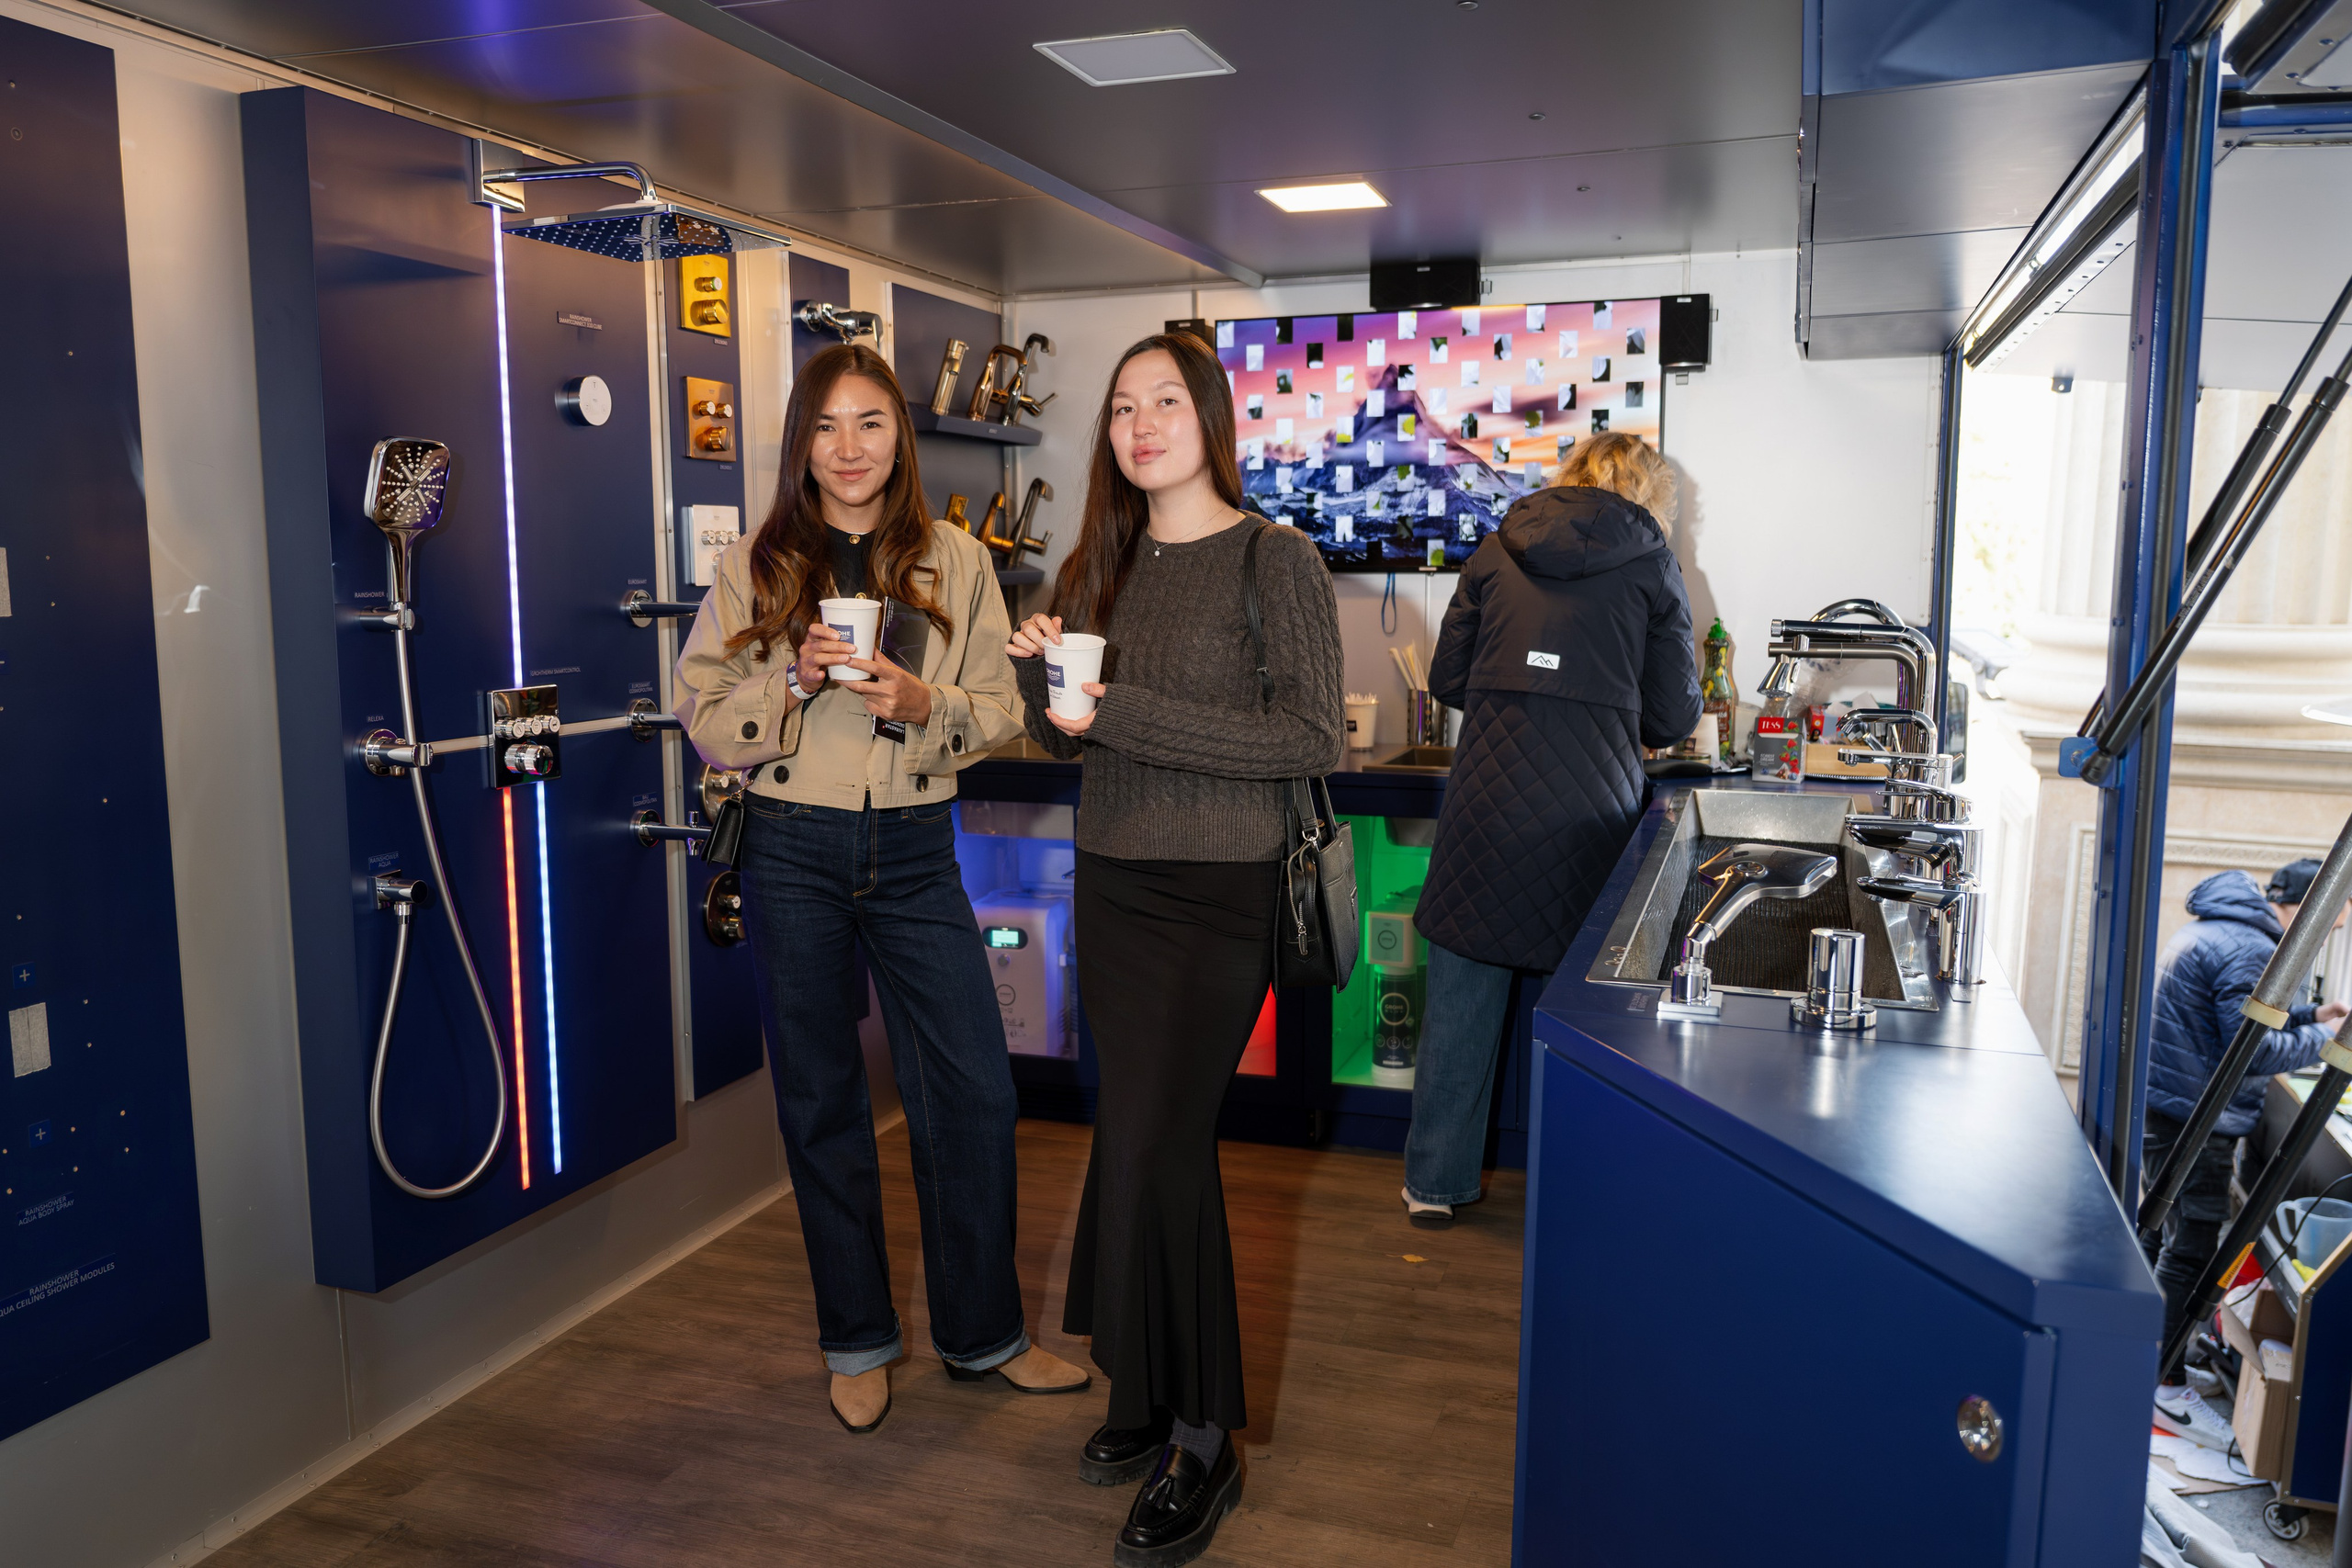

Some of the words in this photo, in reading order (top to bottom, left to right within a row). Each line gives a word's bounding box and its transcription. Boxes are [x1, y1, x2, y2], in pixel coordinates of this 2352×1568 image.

[1762, 720, 1781, 729] TESS
[369, 853, 399, 863] RAINSHOWER
[18, 1214, 37, 1226] AQUA
[38, 1208, 54, 1219] BODY
[56, 1200, 74, 1213] SPRAY
[25, 1195, 67, 1216] RAINSHOWER
[0, 1305, 15, 1317] QUA
[16, 1292, 45, 1309] CEILING
[47, 1278, 79, 1297] SHOWER
[80, 1262, 115, 1282] MODULES
[29, 1269, 80, 1296] RAINSHOWER
